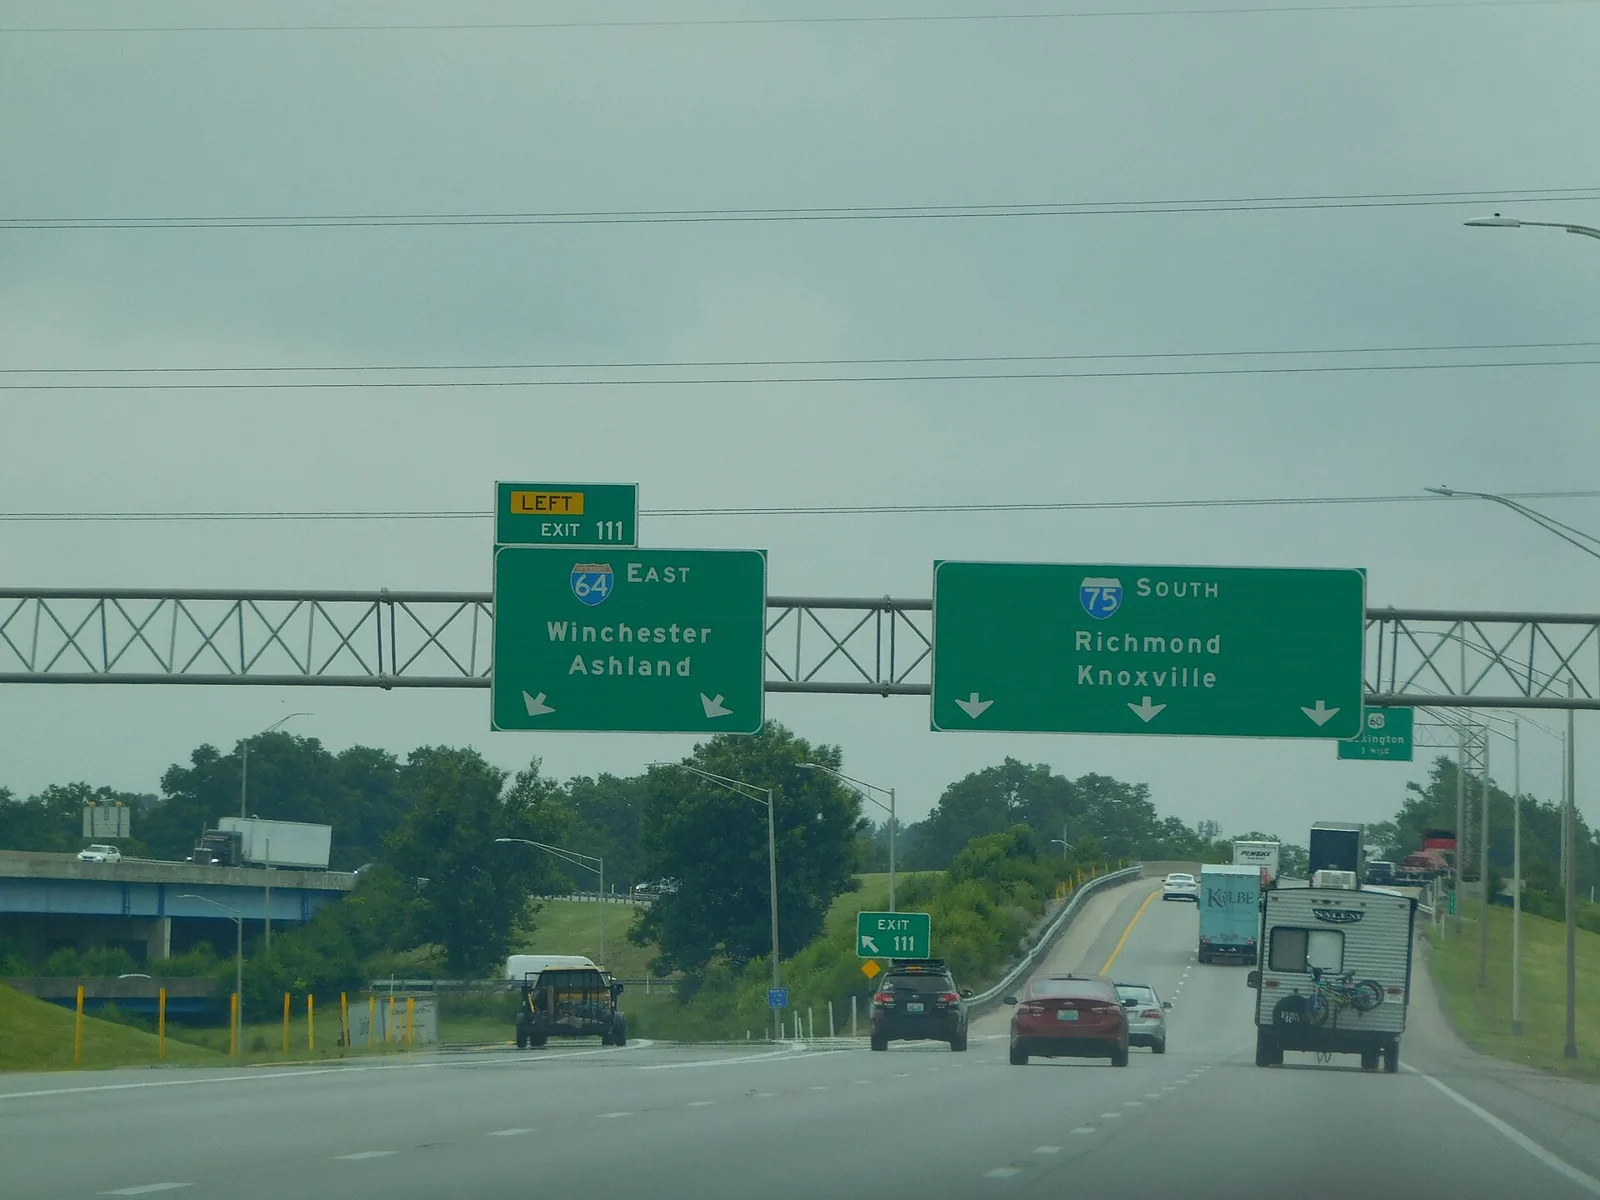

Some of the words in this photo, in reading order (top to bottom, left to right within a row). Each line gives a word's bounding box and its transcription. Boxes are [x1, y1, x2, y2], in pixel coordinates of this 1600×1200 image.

[522, 495, 572, 511] LEFT
[541, 523, 580, 537] EXIT
[596, 521, 623, 541] 111
[575, 573, 608, 597] 64
[627, 563, 690, 584] EAST
[1085, 588, 1118, 611] 75
[1136, 578, 1220, 599] SOUTH
[547, 621, 712, 644] Winchester
[1075, 631, 1222, 655] Richmond
[568, 655, 691, 677] Ashland
[1077, 665, 1218, 689] Knoxville
[1369, 716, 1383, 726] 60
[1347, 735, 1405, 746] xington
[1206, 887, 1256, 909] KOLBE
[878, 919, 910, 931] EXIT
[893, 935, 915, 952] 111
